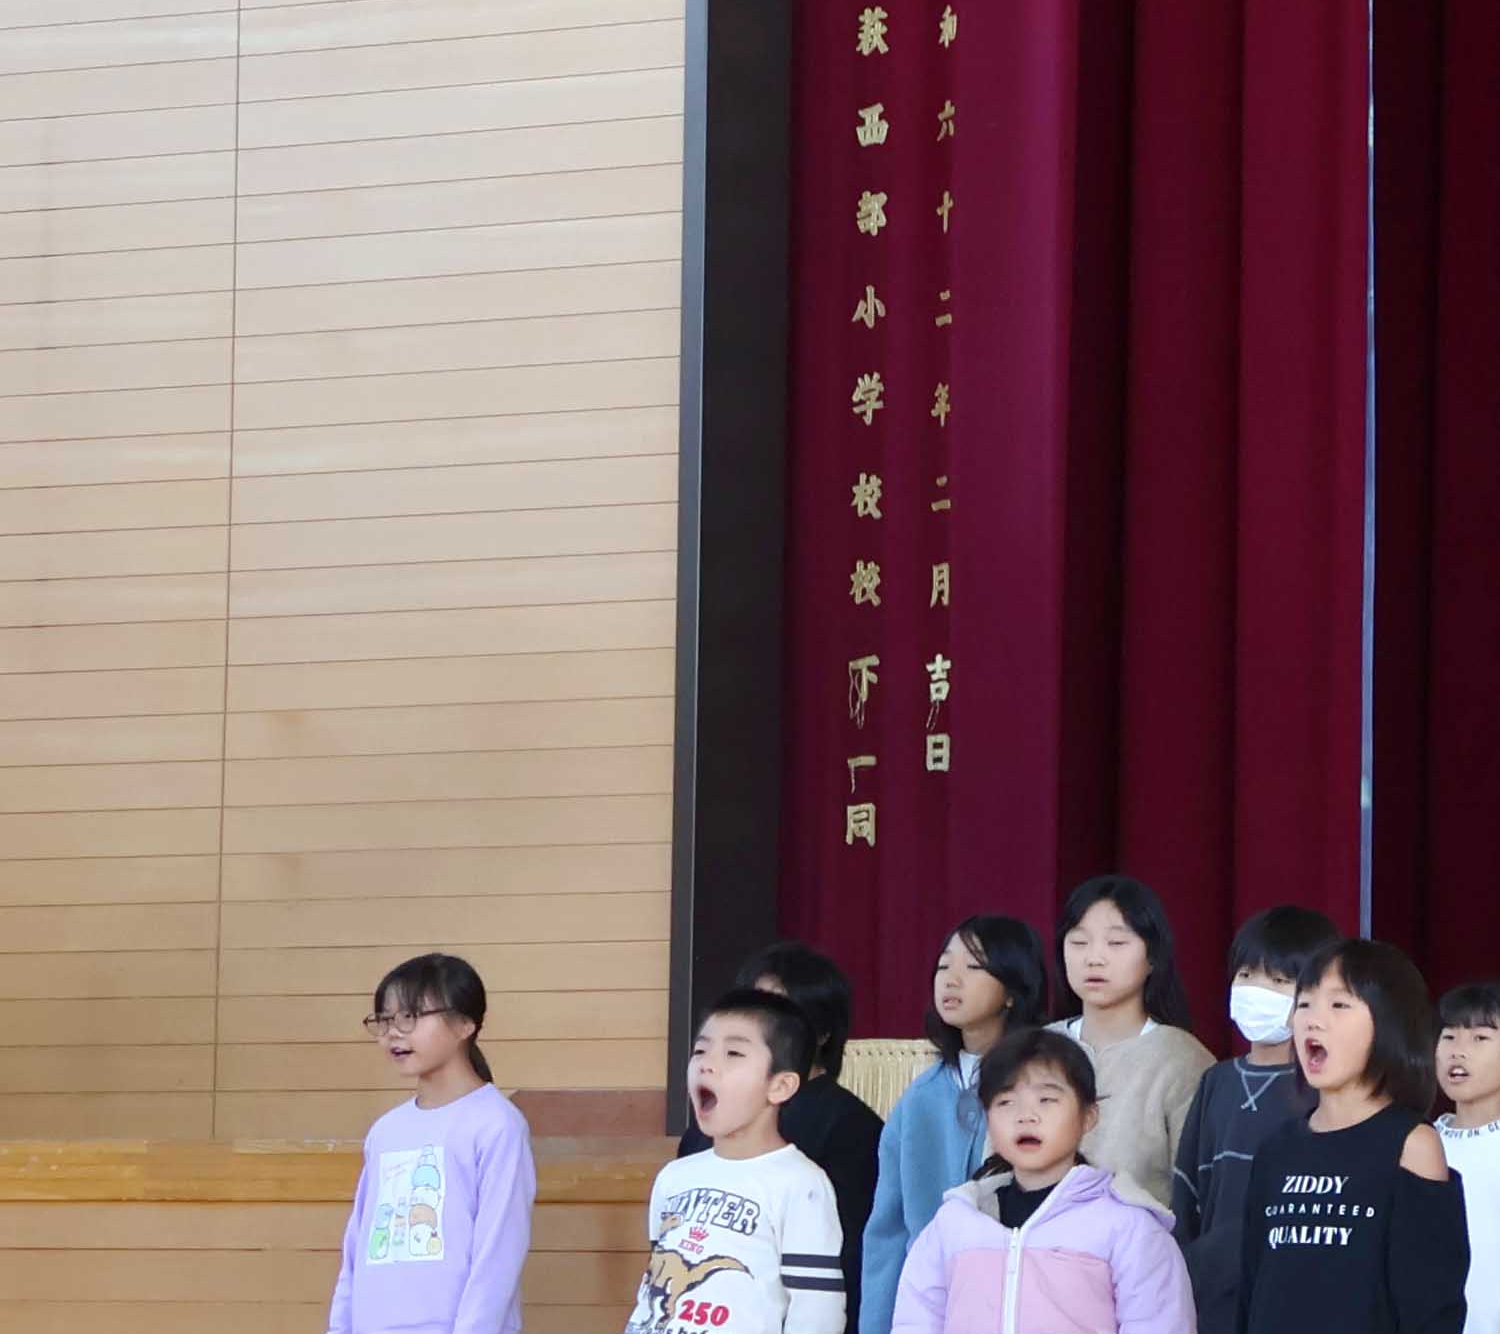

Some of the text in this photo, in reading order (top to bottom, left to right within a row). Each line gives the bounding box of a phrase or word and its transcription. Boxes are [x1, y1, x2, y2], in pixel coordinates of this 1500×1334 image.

[1281, 1175, 1350, 1194] ZIDDY
[1268, 1225, 1352, 1250] QUALITY
[678, 1299, 730, 1326] 250
